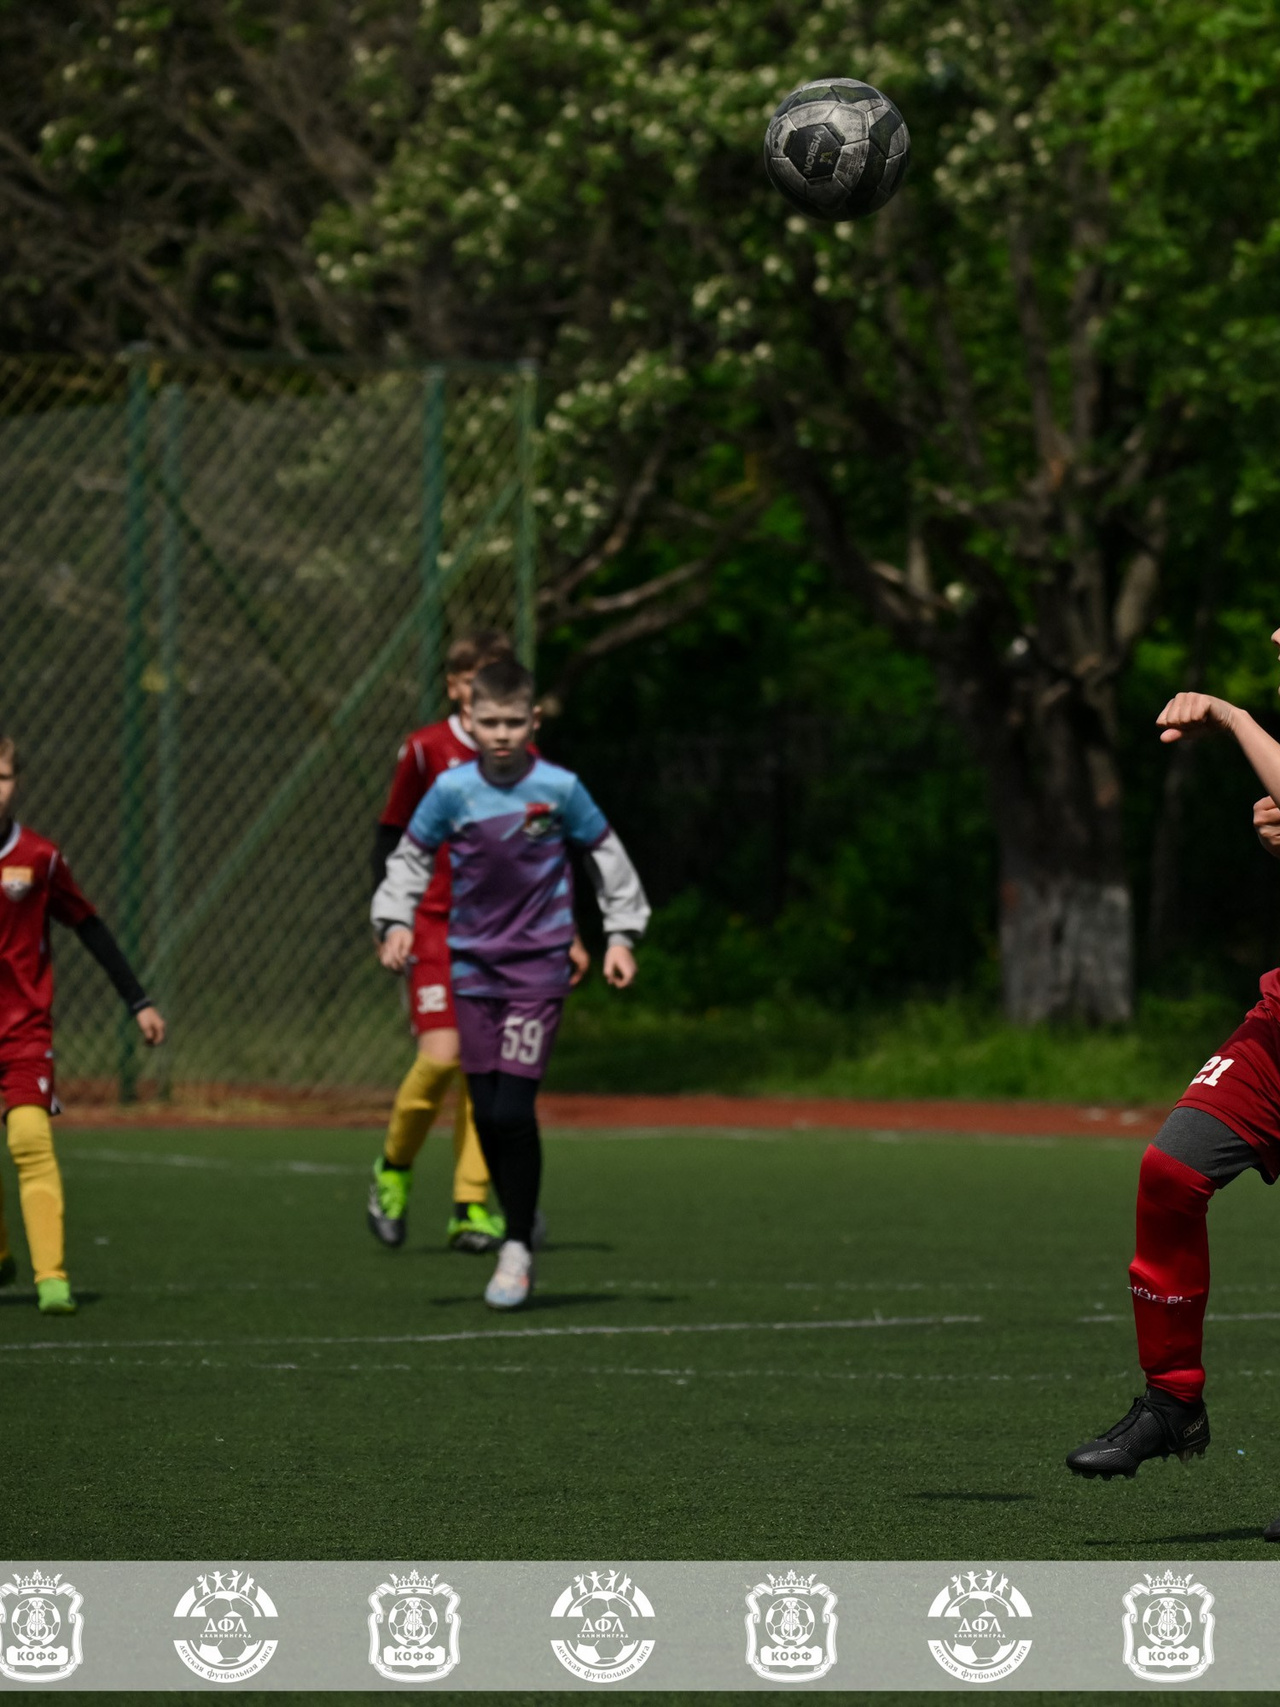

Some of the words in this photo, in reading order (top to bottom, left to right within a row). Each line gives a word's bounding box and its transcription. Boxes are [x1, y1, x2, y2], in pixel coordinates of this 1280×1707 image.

[803, 129, 824, 175] VISION
[500, 1015, 544, 1065] 59
[1190, 1056, 1234, 1086] 21
